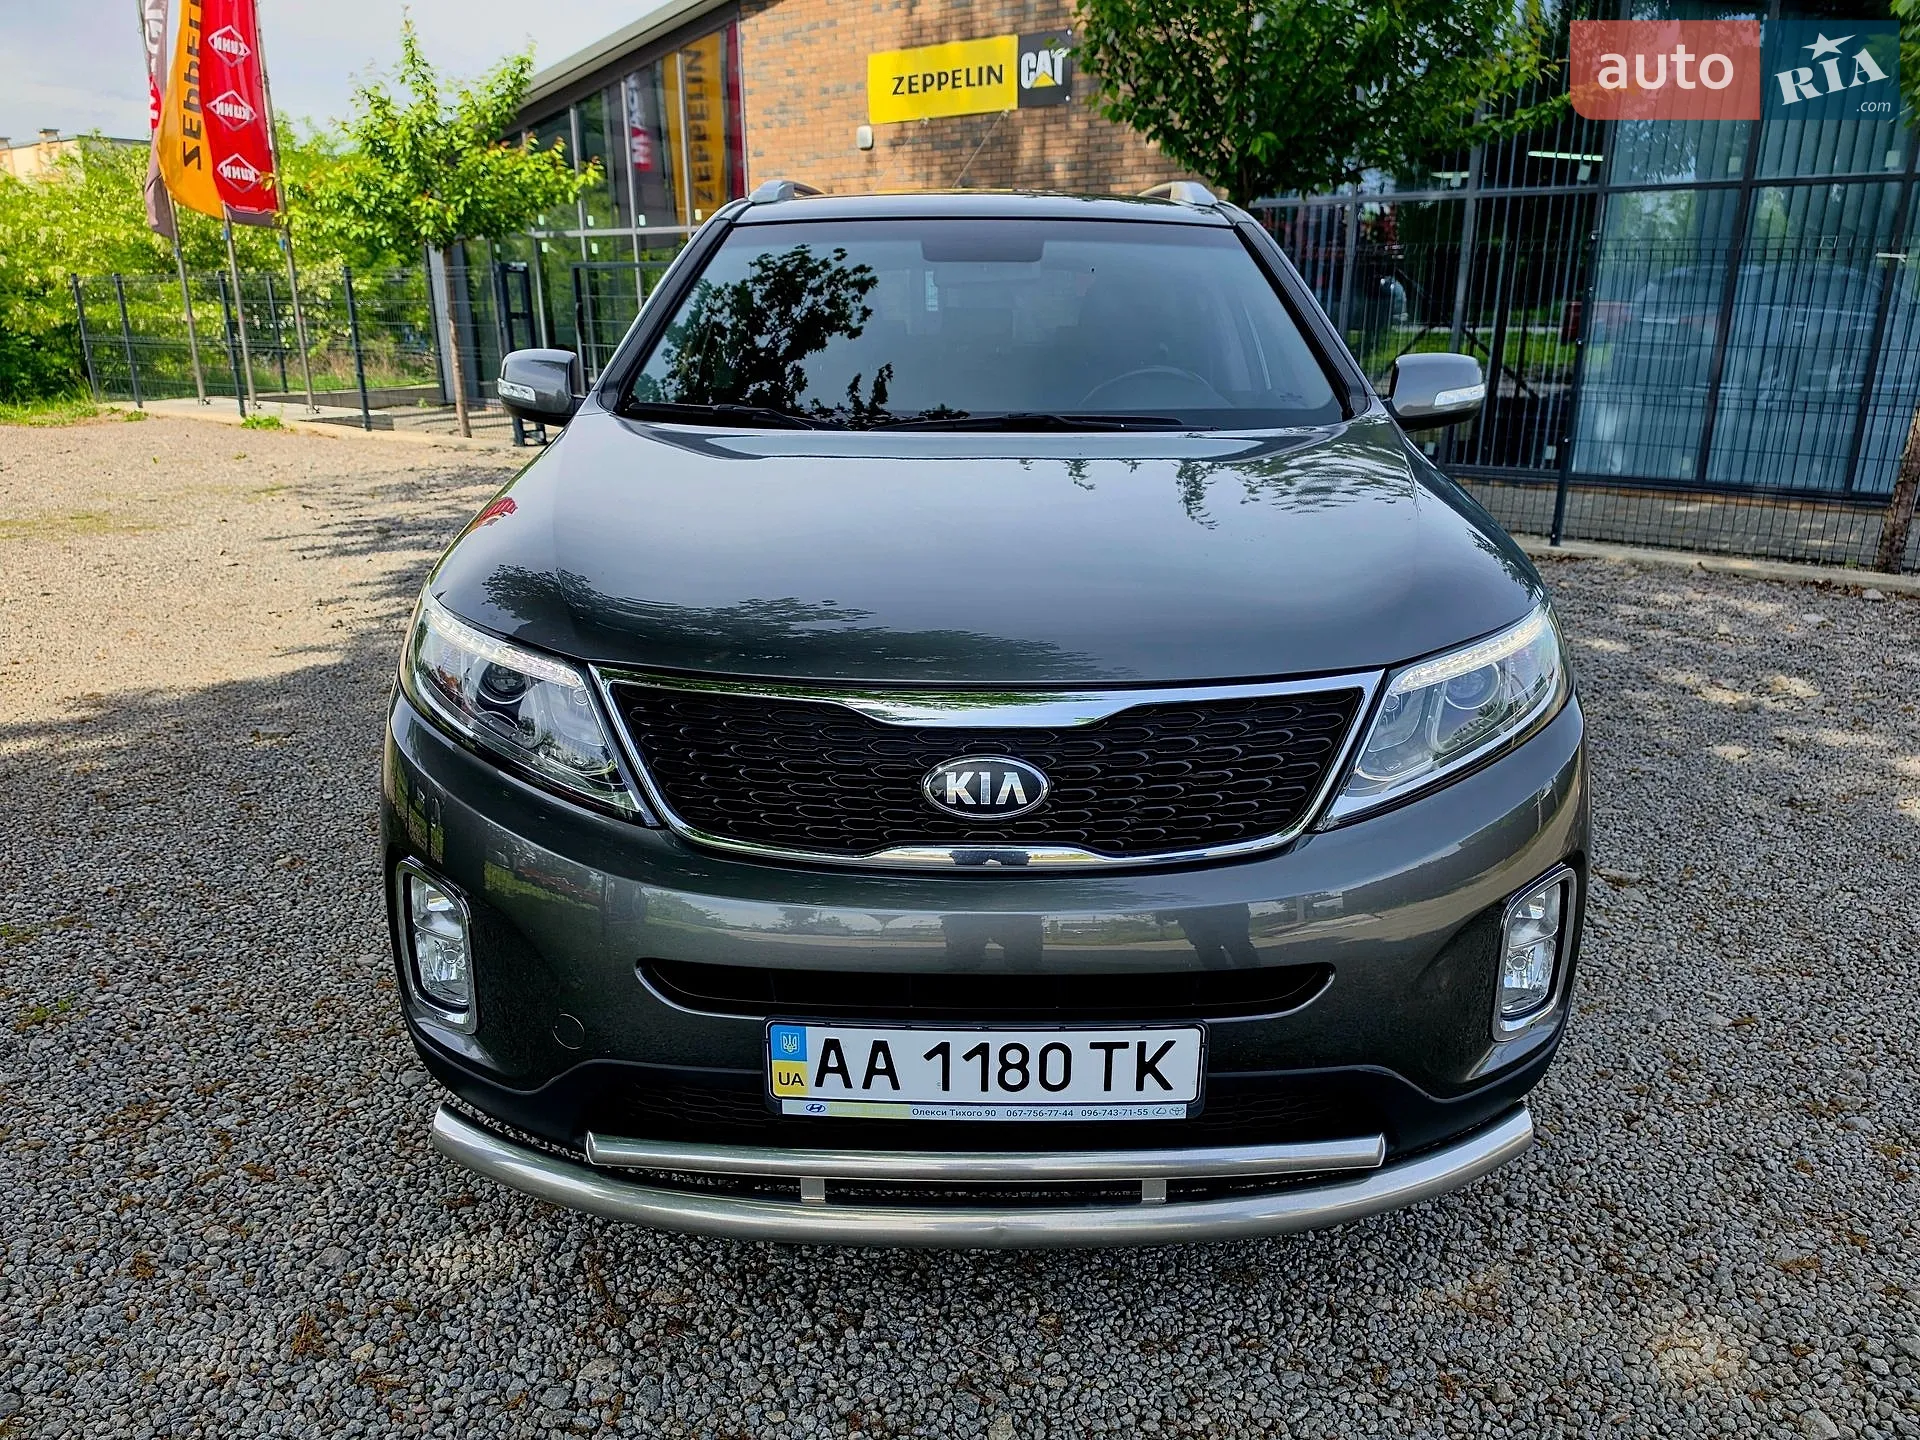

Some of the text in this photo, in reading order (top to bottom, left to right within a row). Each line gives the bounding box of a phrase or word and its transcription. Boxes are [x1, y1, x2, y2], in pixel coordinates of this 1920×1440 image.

[892, 64, 1003, 95] ZEPPELIN
[1020, 50, 1066, 89] CAT
[686, 50, 713, 201] ZEPPELIN
[945, 771, 1028, 805] KIA
[778, 1072, 805, 1087] UA
[815, 1038, 1177, 1092] AA 1180 TK
[912, 1108, 947, 1117] Олекси
[949, 1108, 982, 1118] Тихого
[984, 1109, 997, 1117] 90
[1006, 1109, 1074, 1117] 067-756-77-44
[1081, 1108, 1149, 1117] 096-743-71-55
